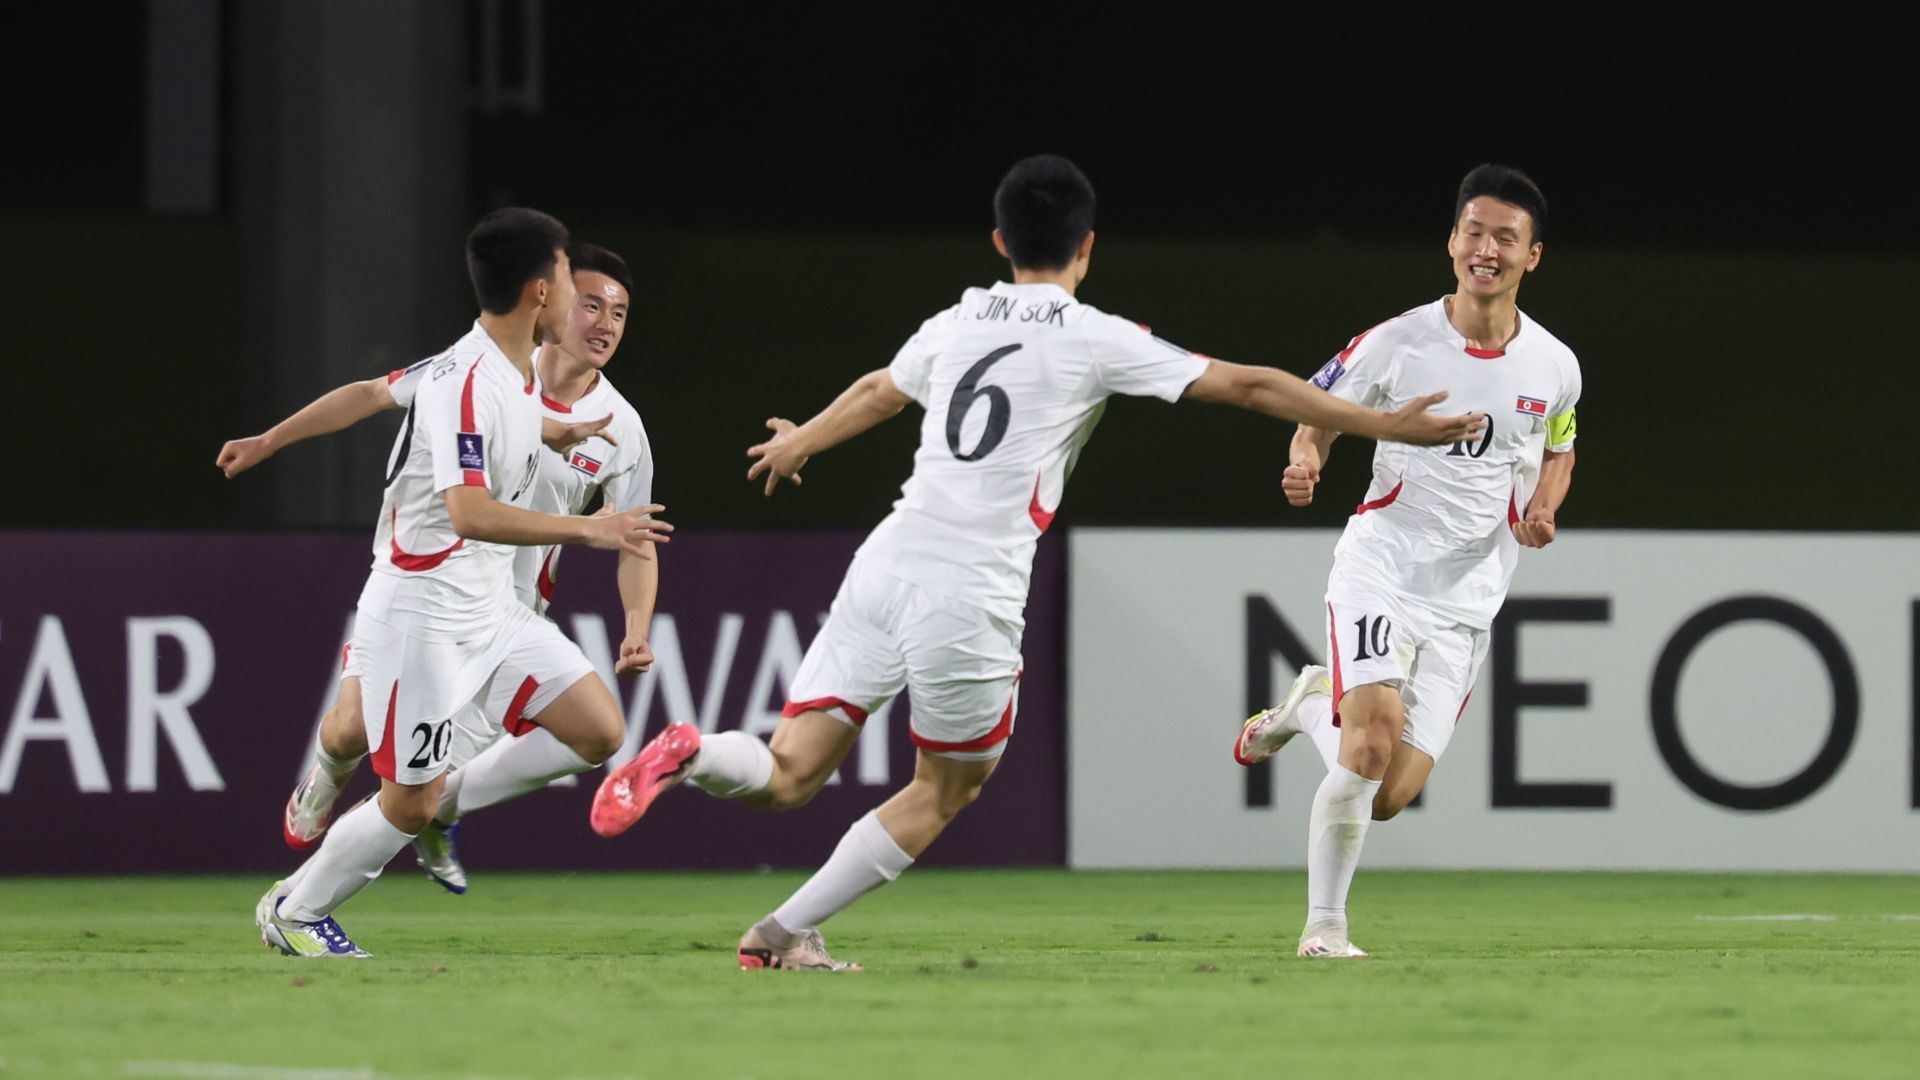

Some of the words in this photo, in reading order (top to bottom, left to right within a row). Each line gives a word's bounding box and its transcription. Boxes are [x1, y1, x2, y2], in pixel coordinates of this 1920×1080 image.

[977, 295, 1018, 322] JIN
[1020, 300, 1070, 327] SOK
[946, 342, 1023, 462] 6
[1354, 614, 1392, 661] 10
[0, 614, 226, 793] AR
[407, 719, 452, 768] 20
[1245, 594, 1920, 812] NEO
